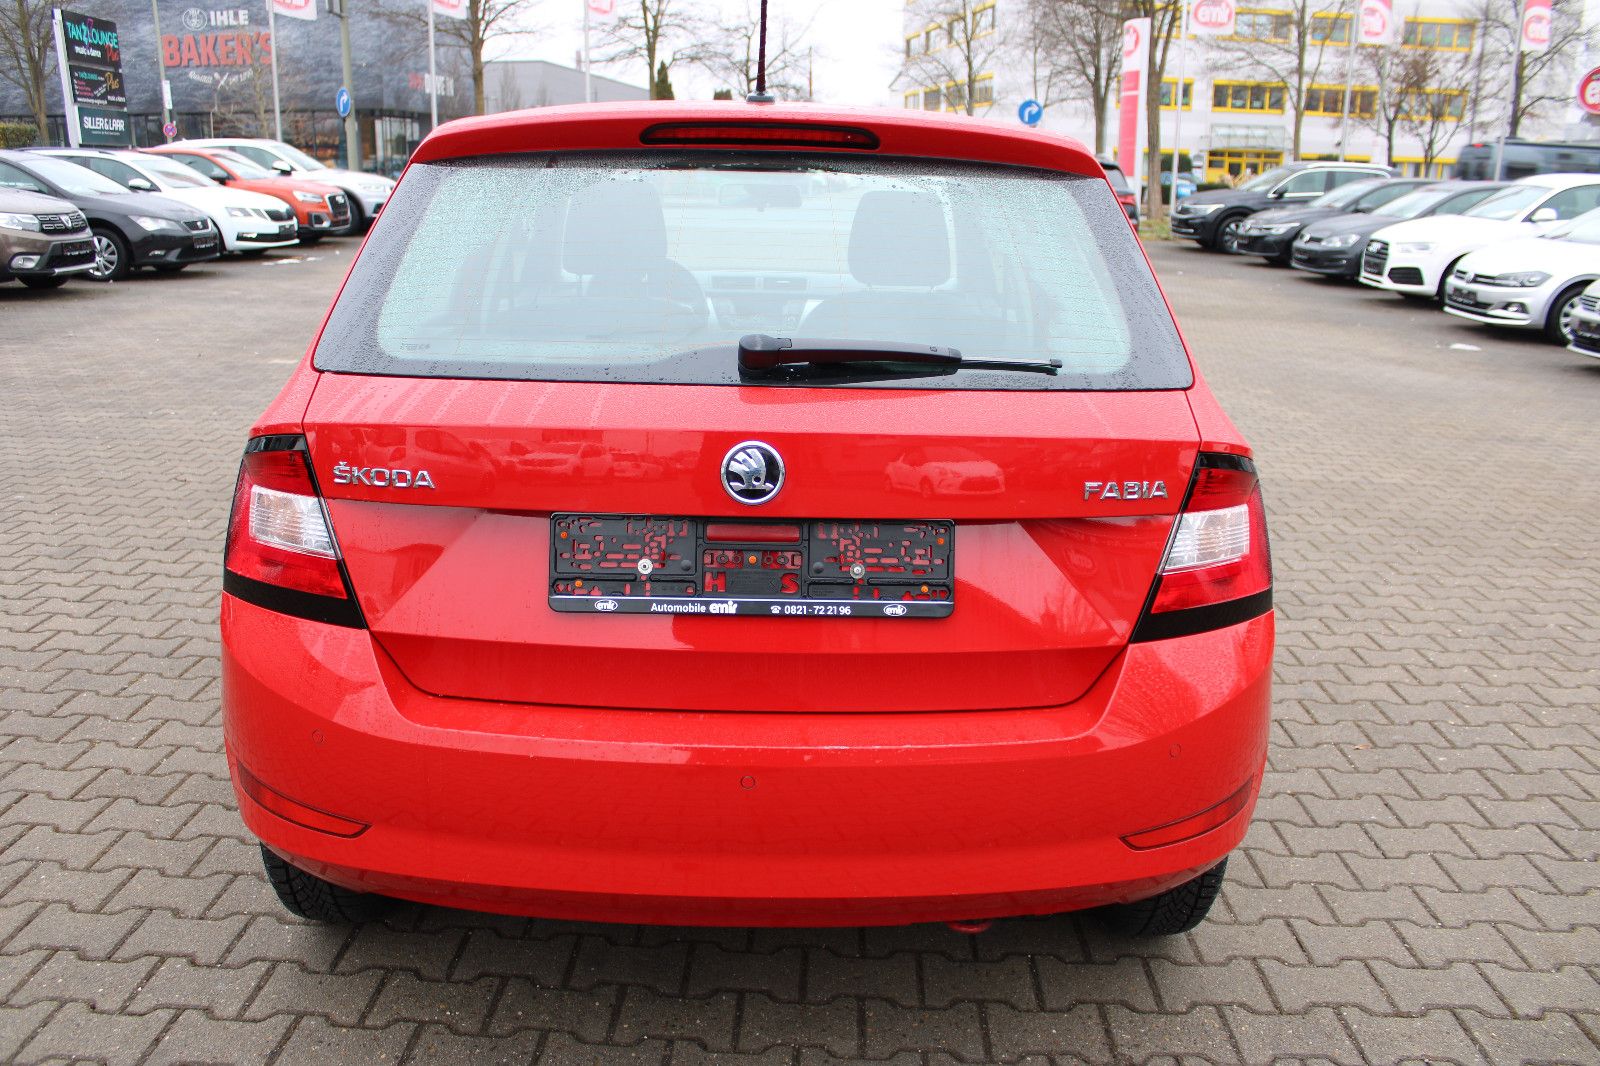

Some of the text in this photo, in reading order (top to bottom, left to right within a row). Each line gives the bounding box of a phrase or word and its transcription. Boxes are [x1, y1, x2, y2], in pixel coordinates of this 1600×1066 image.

[209, 9, 249, 27] IHLE
[161, 32, 271, 66] BAKER'S
[332, 461, 436, 489] ŠKODA
[1083, 480, 1169, 500] FABIA
[650, 600, 738, 614] Automobile emir
